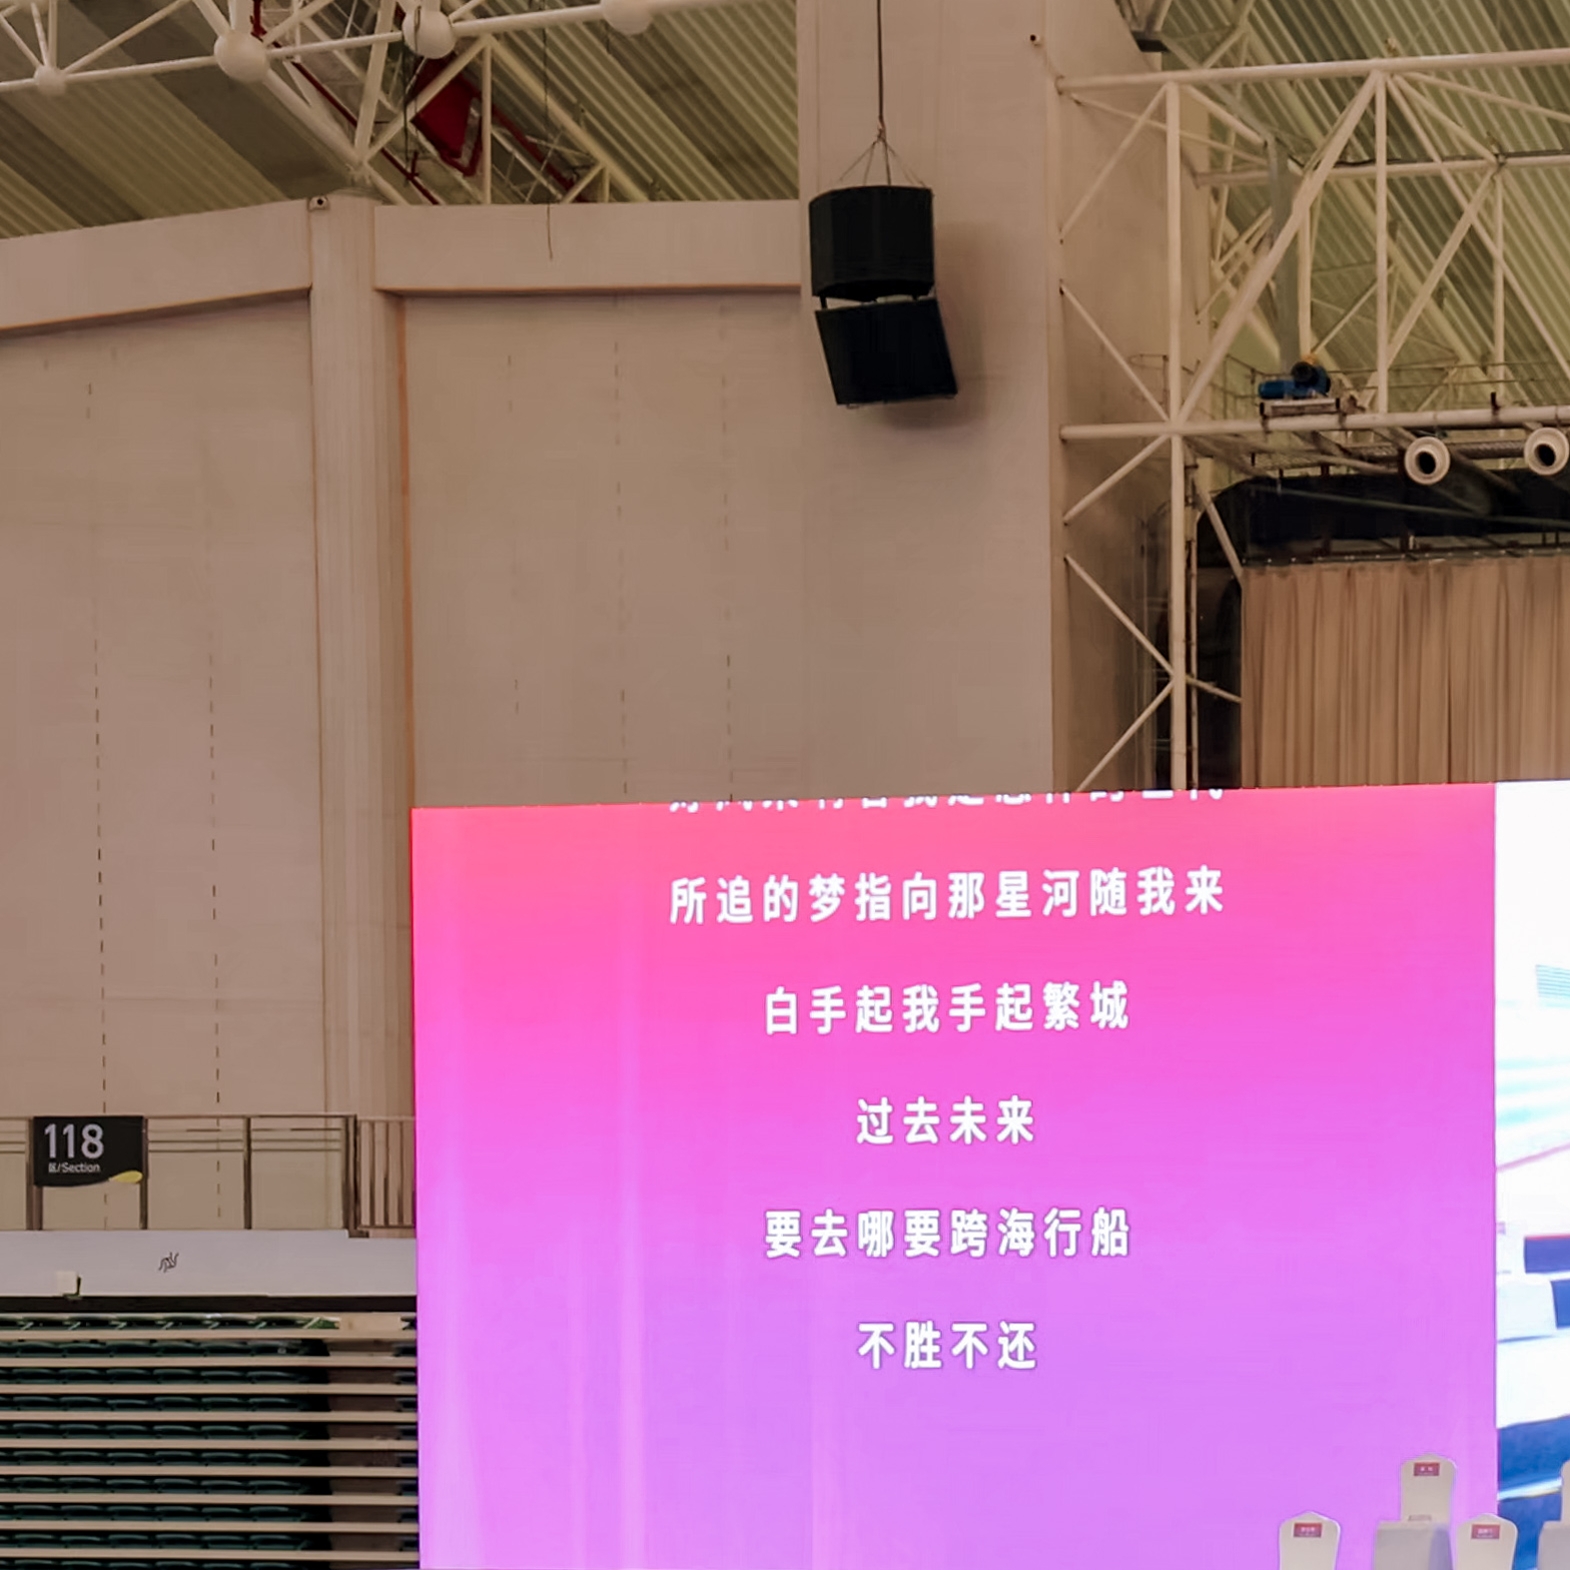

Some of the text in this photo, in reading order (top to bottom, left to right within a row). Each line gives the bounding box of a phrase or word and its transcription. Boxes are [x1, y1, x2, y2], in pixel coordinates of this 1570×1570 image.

[669, 864, 1224, 924] 所追的梦指向那星河随我来
[766, 979, 1129, 1035] 白手起我手起繁城
[45, 1124, 104, 1159] 118
[856, 1094, 1034, 1145] 过去未来
[764, 1206, 1130, 1259] 要去哪要跨海行船
[857, 1319, 1036, 1370] 不胜不还
